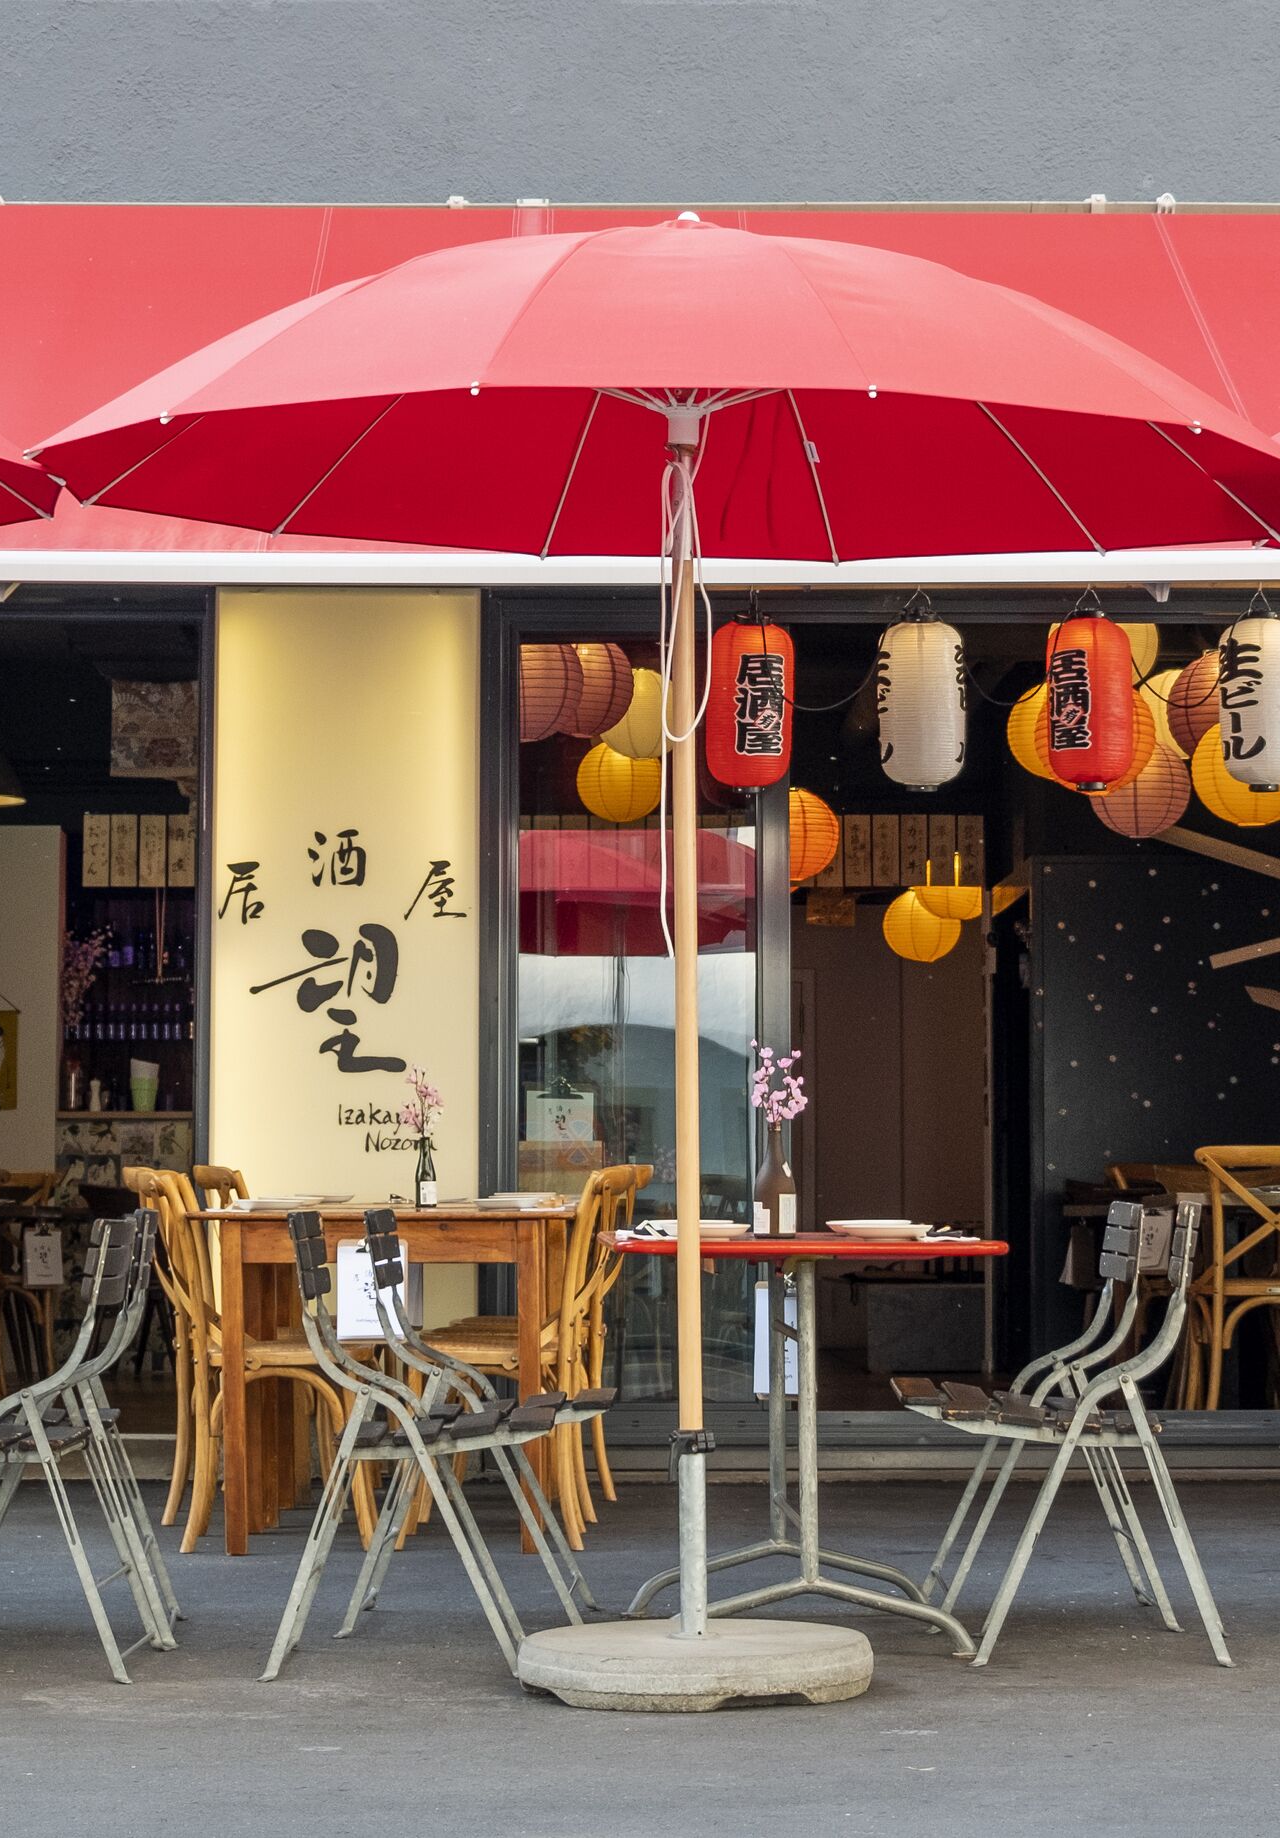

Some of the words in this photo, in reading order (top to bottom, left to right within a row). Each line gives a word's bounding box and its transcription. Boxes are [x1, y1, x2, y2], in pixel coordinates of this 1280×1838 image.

[734, 653, 785, 756] 居酒屋
[1219, 638, 1266, 761] 生ビール
[249, 923, 407, 1073] 望
